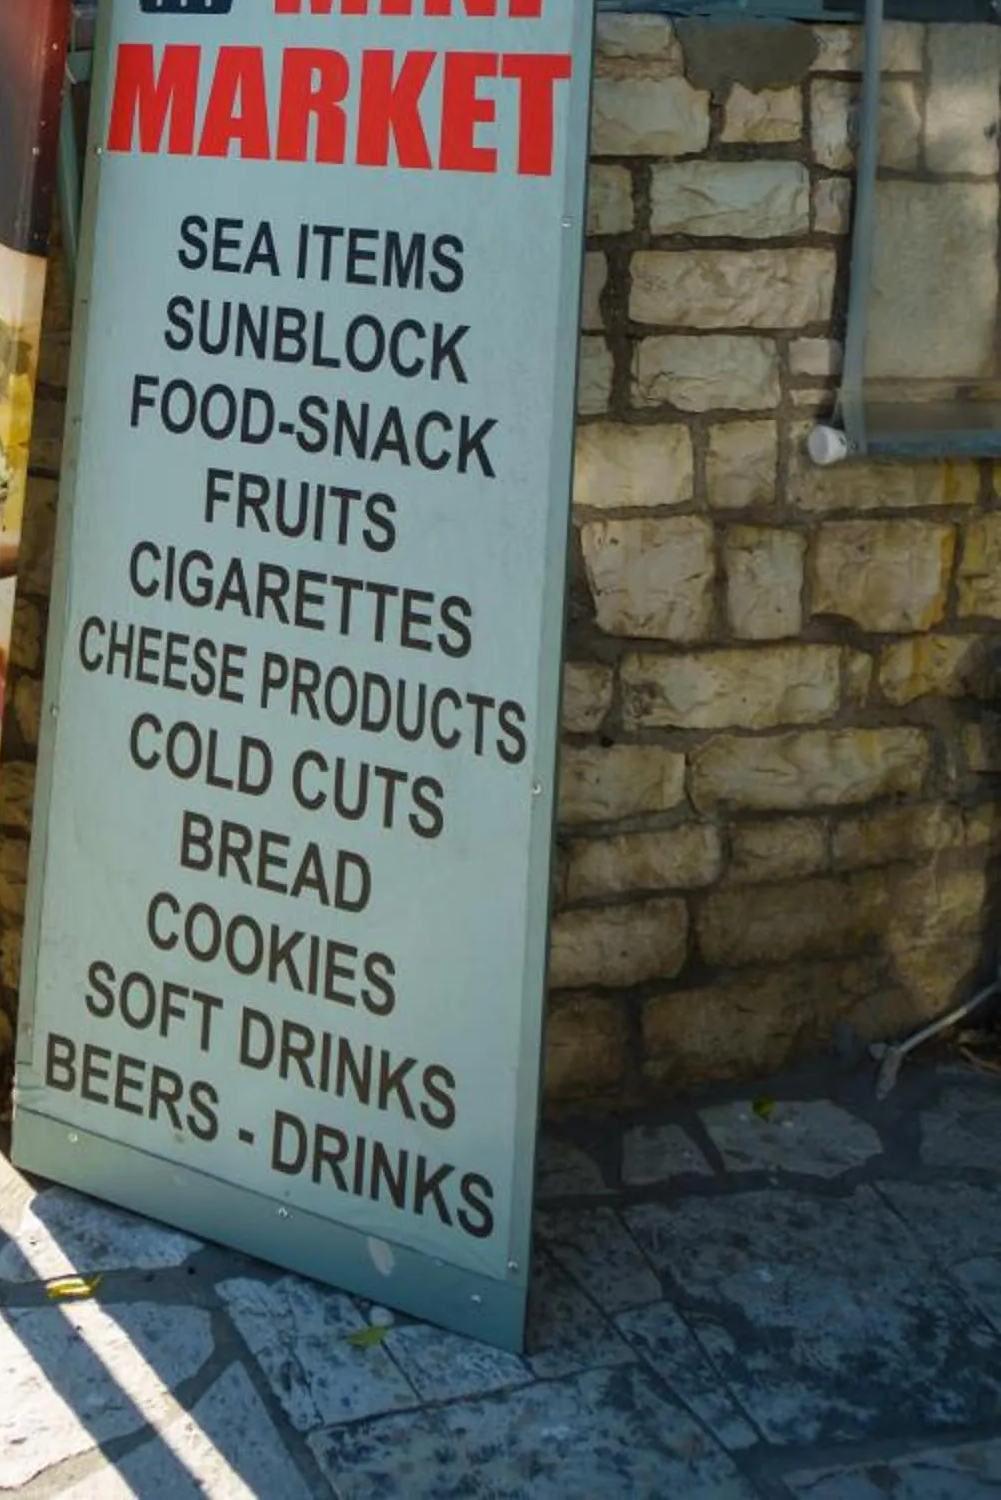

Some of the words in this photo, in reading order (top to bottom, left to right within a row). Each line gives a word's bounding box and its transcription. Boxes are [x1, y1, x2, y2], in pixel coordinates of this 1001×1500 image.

[107, 43, 572, 177] MARKET
[177, 215, 280, 277] SEA
[297, 223, 464, 293] ITEMS
[164, 296, 471, 384] SUNBLOCK
[129, 374, 499, 479] FOOD-SNACK
[204, 468, 396, 553] FRUITS
[129, 541, 472, 658] CIGARETTES
[79, 616, 247, 704] CHEESE
[260, 651, 526, 764] PRODUCTS
[129, 713, 273, 797] COLD
[292, 750, 445, 839] CUTS
[180, 810, 371, 913] BREAD
[147, 892, 396, 1017] COOKIES
[85, 960, 224, 1052] SOFT
[240, 1006, 456, 1130] DRINKS
[45, 1032, 219, 1142] BEERS
[271, 1109, 495, 1240] DRINKS
